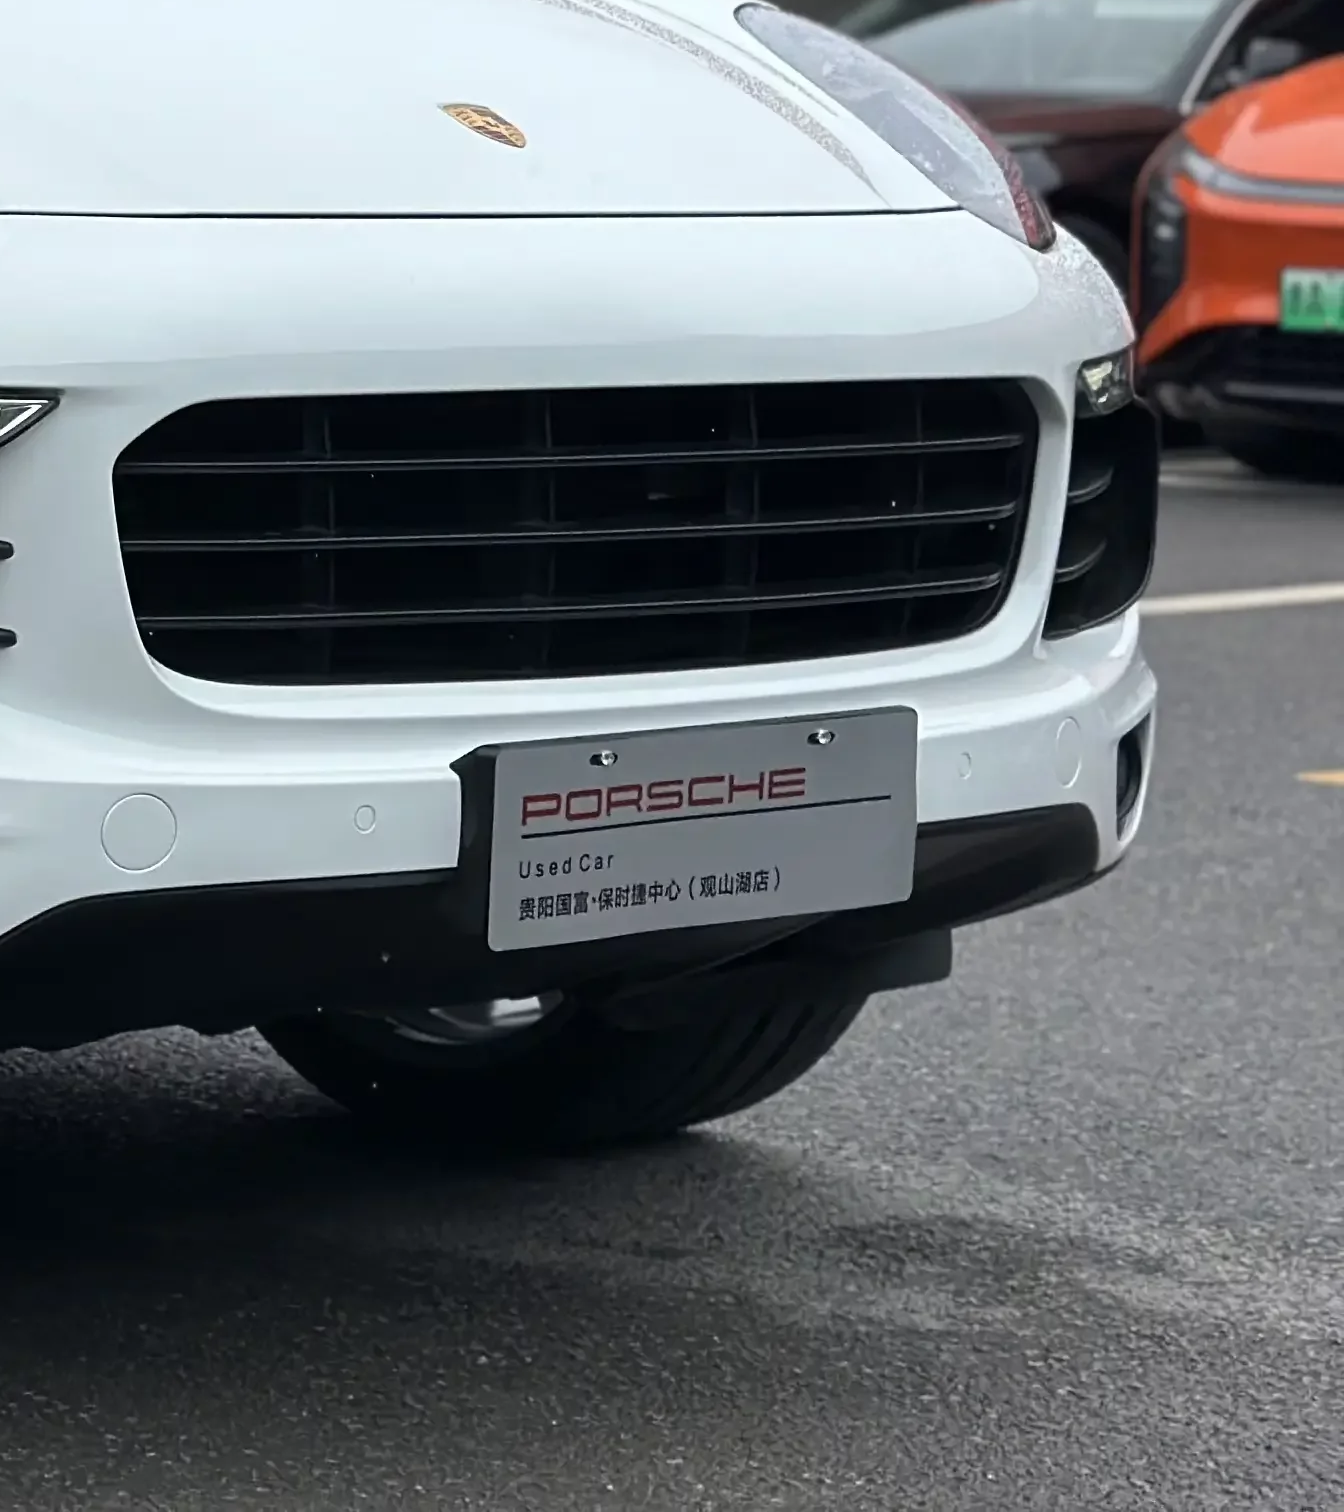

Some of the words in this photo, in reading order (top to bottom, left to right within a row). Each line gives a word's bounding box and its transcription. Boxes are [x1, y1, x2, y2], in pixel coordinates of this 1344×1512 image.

[521, 767, 806, 826] PORSCHE
[518, 857, 572, 879] Used
[579, 853, 614, 872] Car
